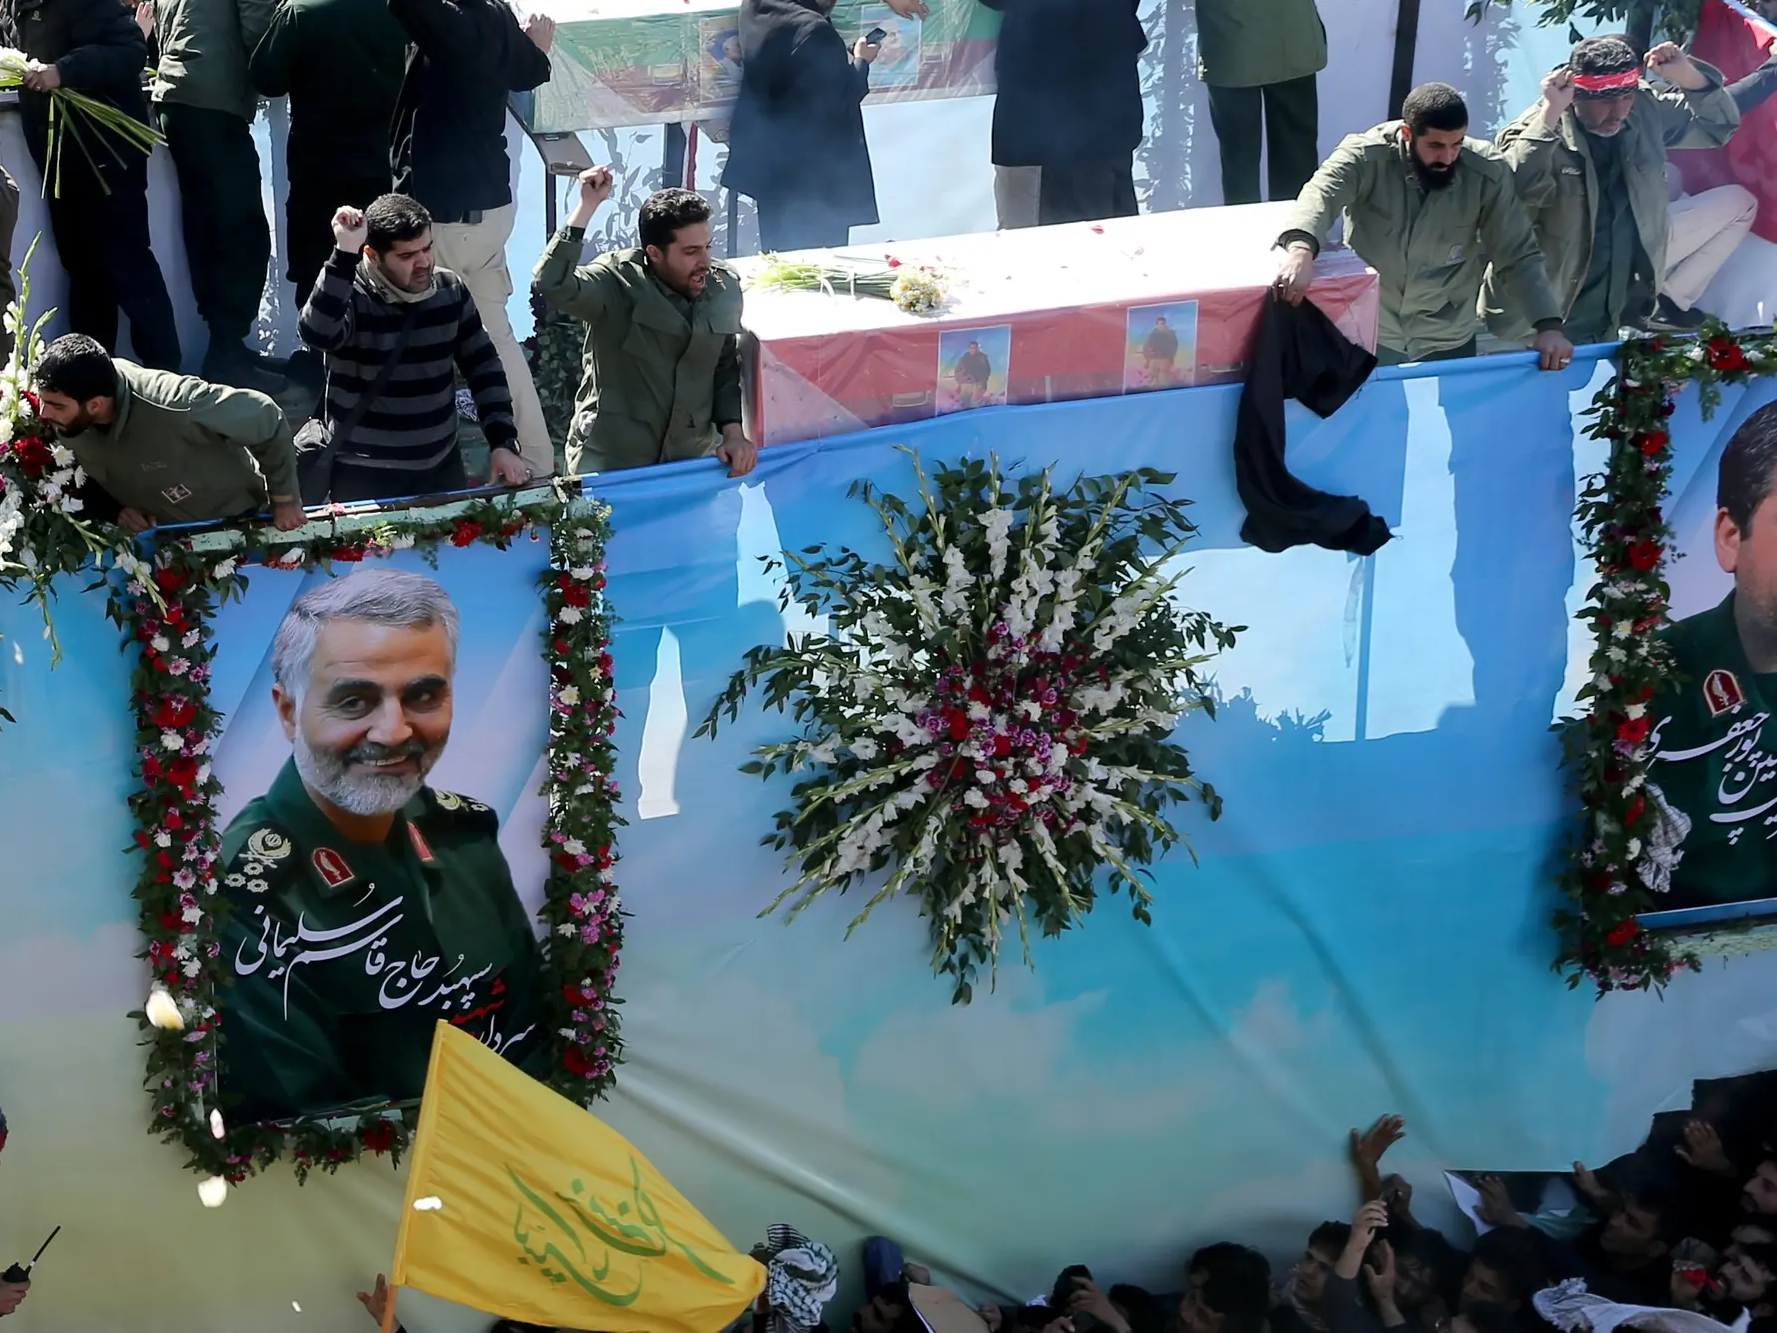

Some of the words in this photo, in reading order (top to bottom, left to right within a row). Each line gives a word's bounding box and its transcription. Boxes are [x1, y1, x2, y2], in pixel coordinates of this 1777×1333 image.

[233, 895, 404, 980] سلیمانی
[282, 913, 404, 1022] قاسم
[377, 949, 441, 1009] حاج
[417, 954, 494, 1011] سپهبد
